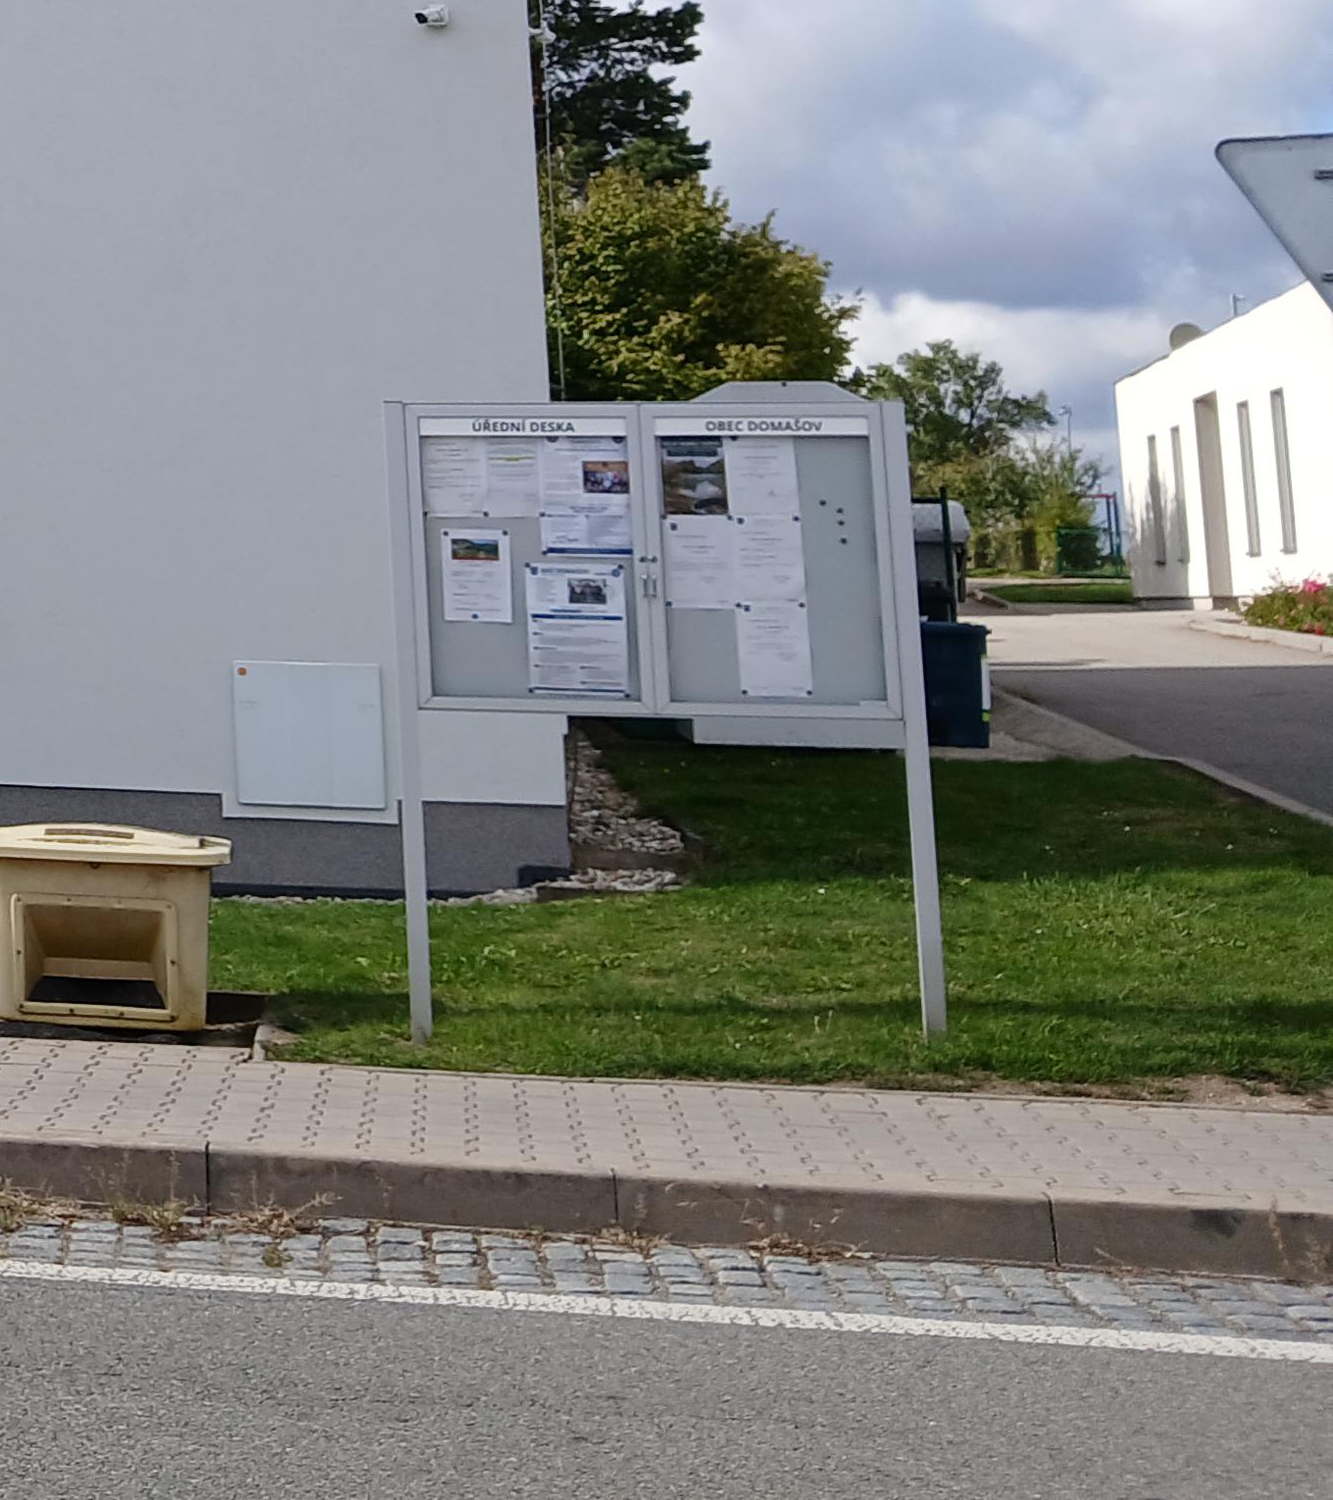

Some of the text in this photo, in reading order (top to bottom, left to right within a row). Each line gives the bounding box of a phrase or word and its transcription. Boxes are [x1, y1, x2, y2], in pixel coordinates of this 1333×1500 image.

[471, 419, 575, 433] ÚŘEDNÍ DESKA
[704, 418, 823, 432] OBEC DOMAŠOV
